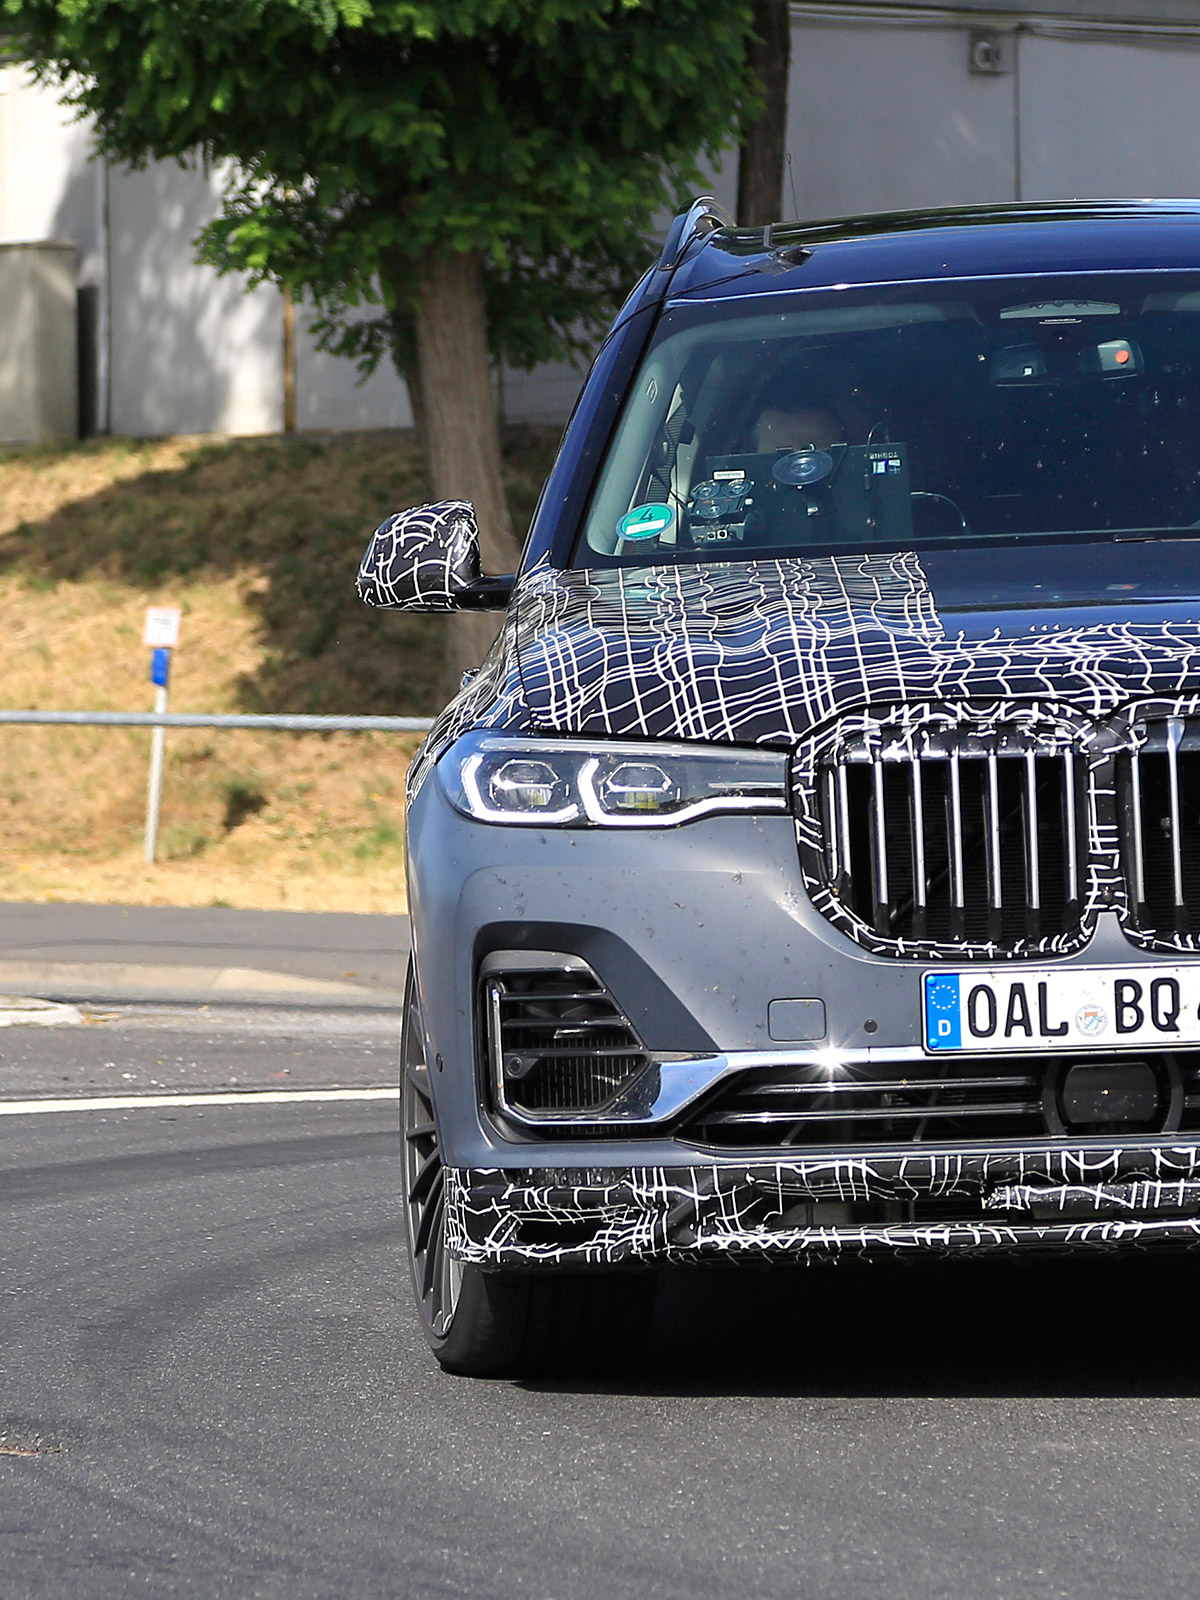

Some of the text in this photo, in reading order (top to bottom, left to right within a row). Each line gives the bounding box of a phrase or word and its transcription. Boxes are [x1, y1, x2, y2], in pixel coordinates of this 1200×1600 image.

[866, 451, 899, 460] TOSHIB
[639, 507, 655, 521] 4
[967, 981, 1069, 1038] OAL
[1114, 977, 1181, 1034] BQ
[937, 1019, 952, 1036] D
